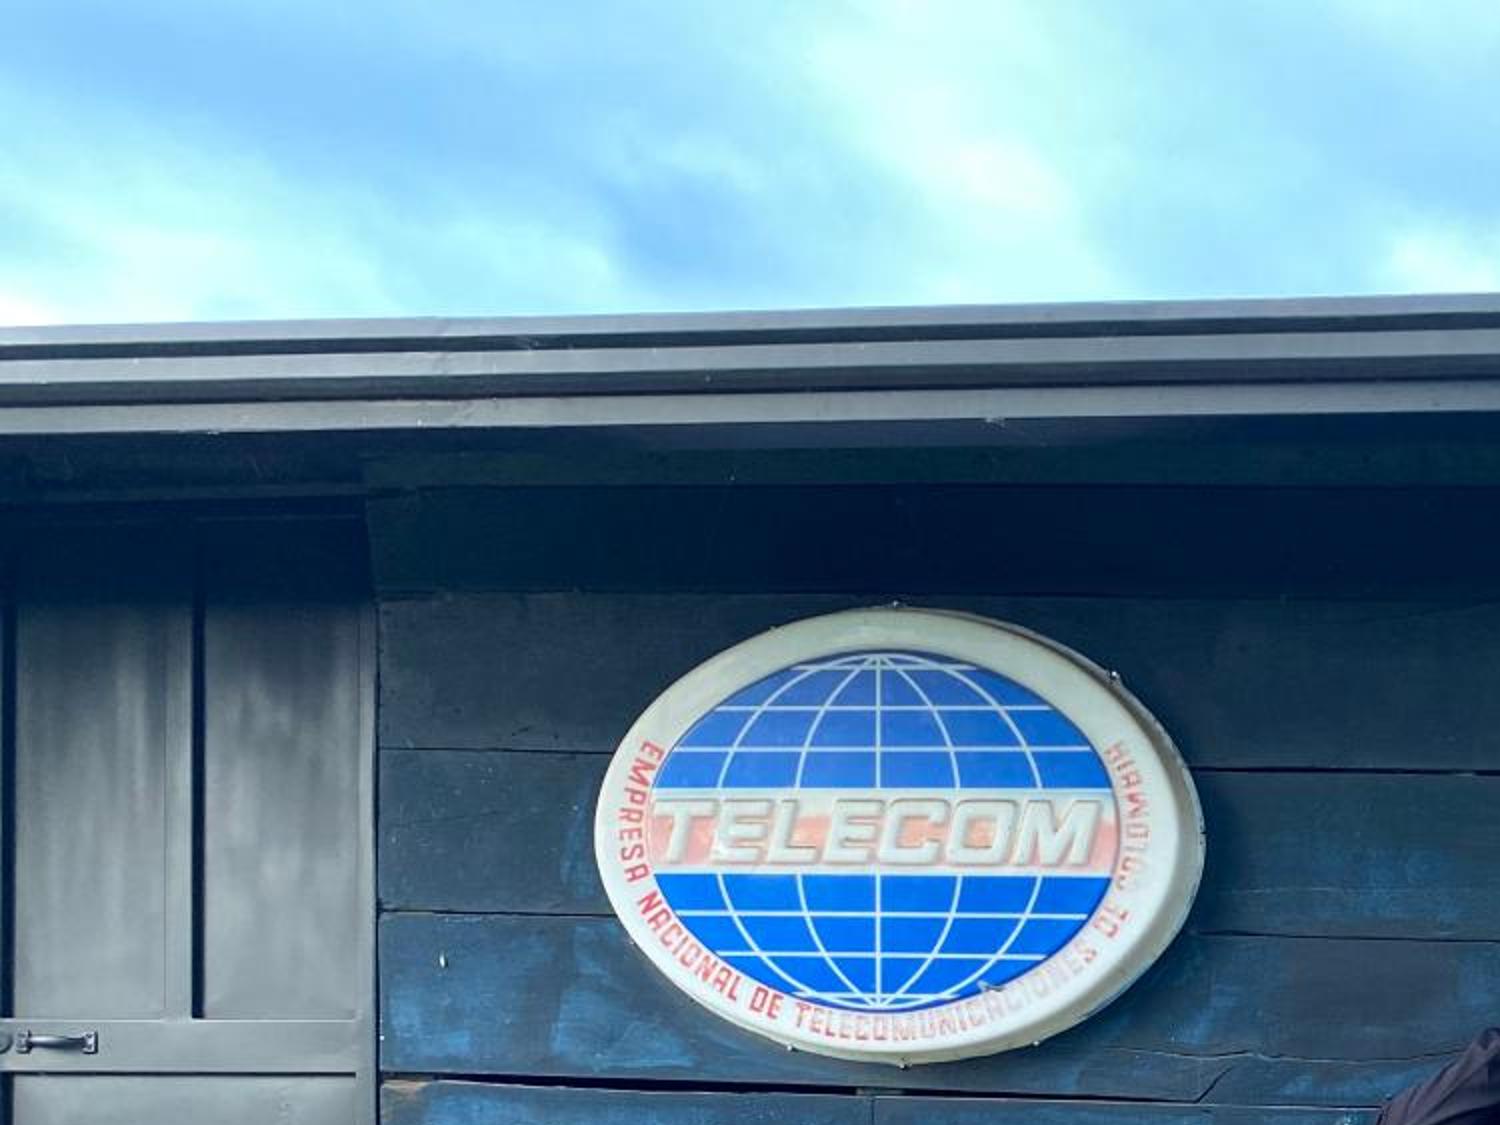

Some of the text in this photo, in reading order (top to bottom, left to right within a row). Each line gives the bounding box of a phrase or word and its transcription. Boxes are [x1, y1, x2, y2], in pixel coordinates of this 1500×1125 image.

[618, 740, 666, 883] EMPRESA
[653, 797, 1099, 866] TELECOM
[637, 892, 744, 1002] NACIONAL
[1092, 902, 1129, 939] DE
[748, 986, 785, 1019] DE
